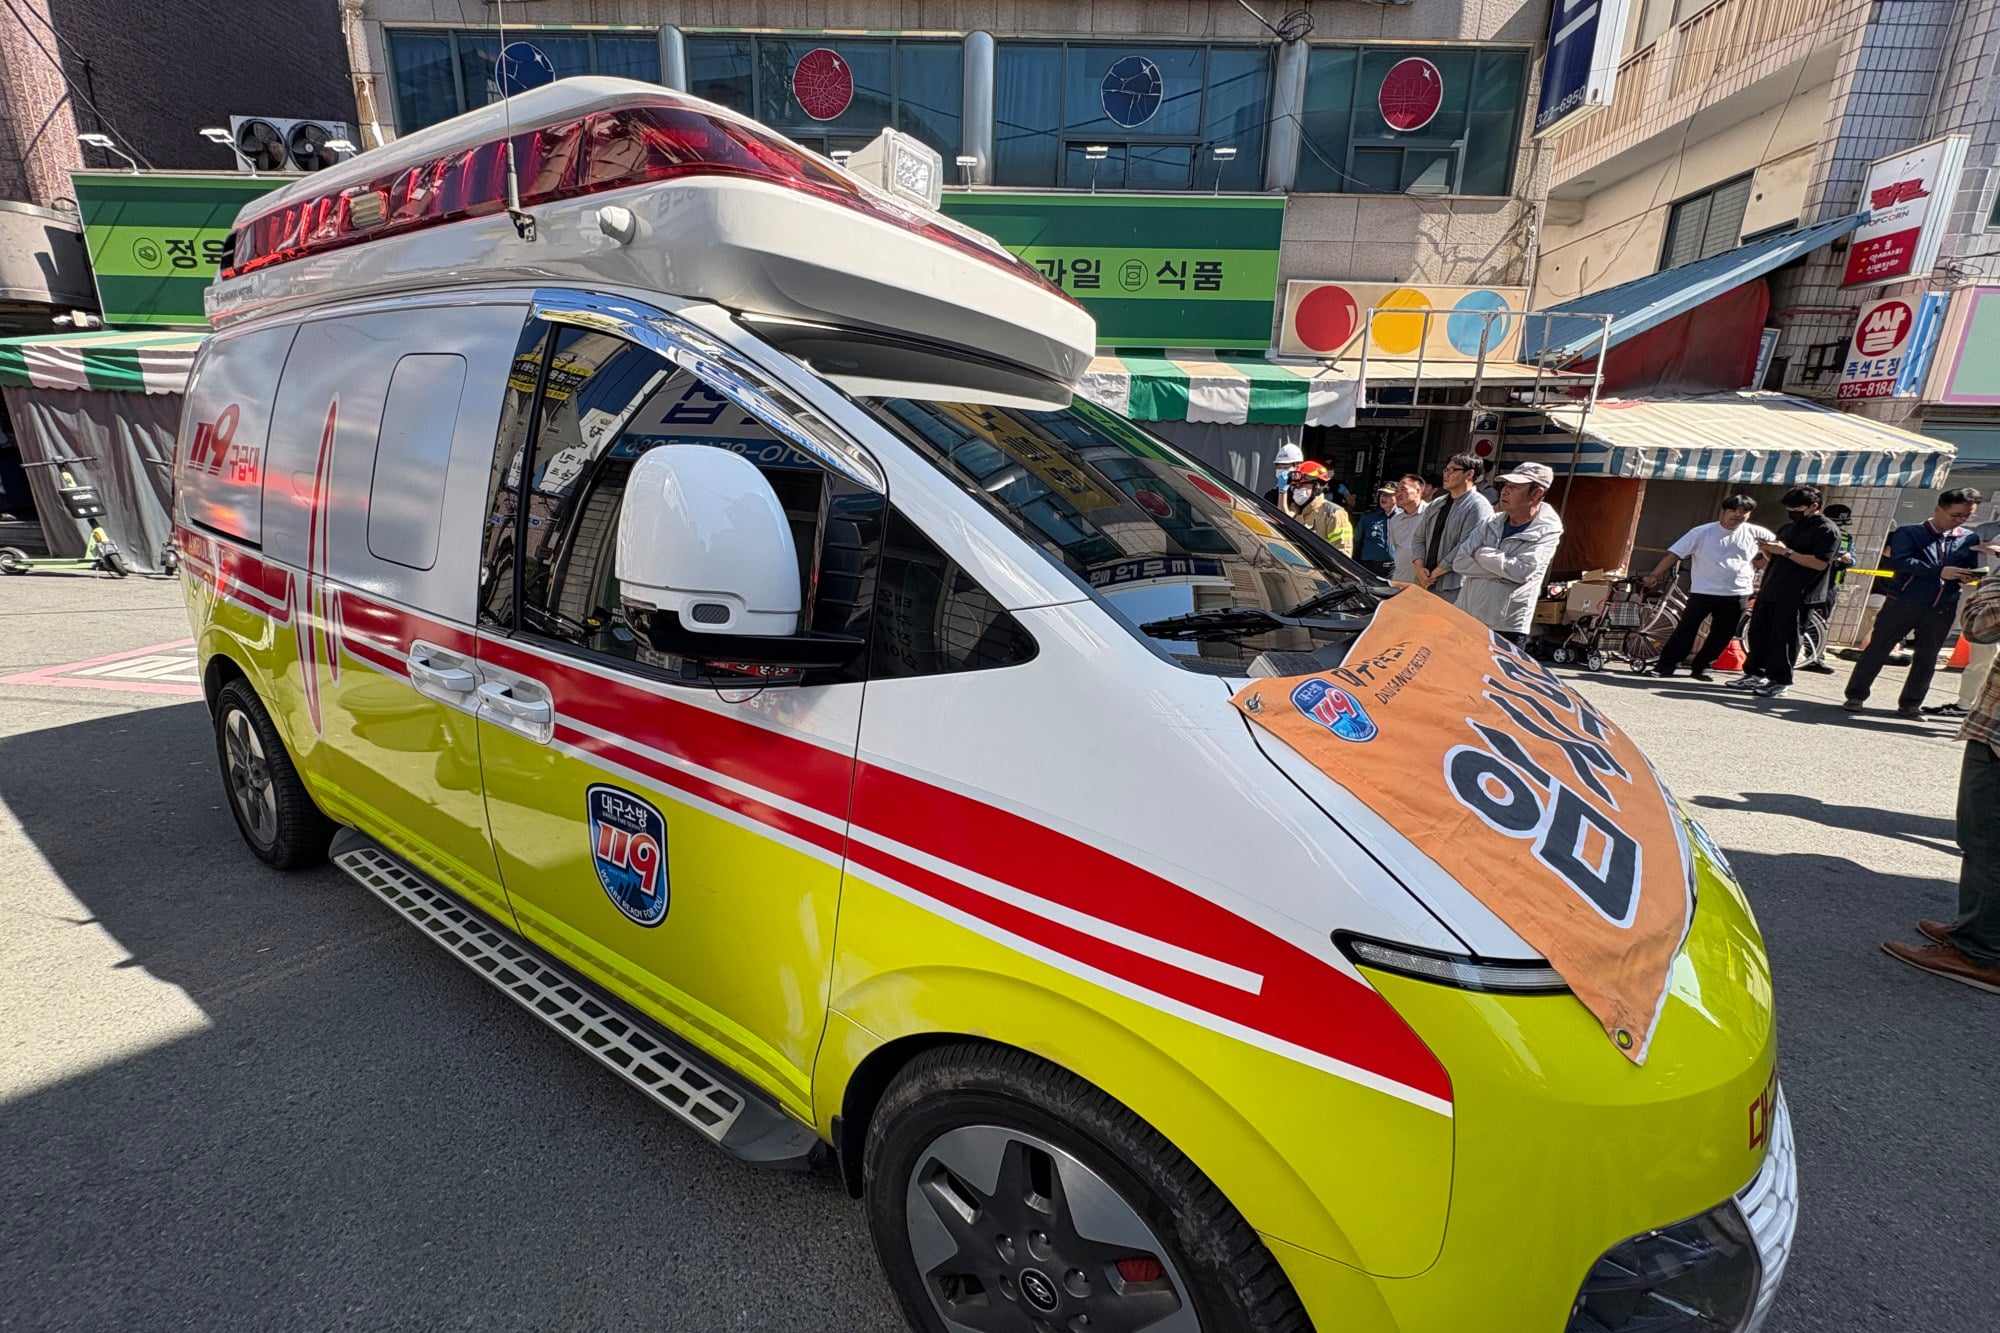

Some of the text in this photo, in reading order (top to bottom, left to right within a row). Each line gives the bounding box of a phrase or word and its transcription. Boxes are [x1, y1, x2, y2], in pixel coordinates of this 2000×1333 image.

[1536, 84, 1586, 128] 322-6950
[1036, 258, 1101, 289] 과일
[1155, 260, 1224, 291] 식품
[1862, 306, 1907, 353] 쌀
[1846, 357, 1902, 379] 즉석도정
[1840, 380, 1894, 398] 325-8184
[188, 403, 240, 476] 119
[1483, 421, 1491, 430] 5
[229, 444, 261, 483] 구급대
[1309, 687, 1358, 726] 119
[601, 793, 648, 828] 대구소방
[597, 818, 661, 896] 119
[601, 869, 611, 885] WE
[608, 886, 622, 903] ARE
[621, 899, 643, 918] READY
[642, 907, 657, 919] FOR
[652, 895, 664, 912] YOU
